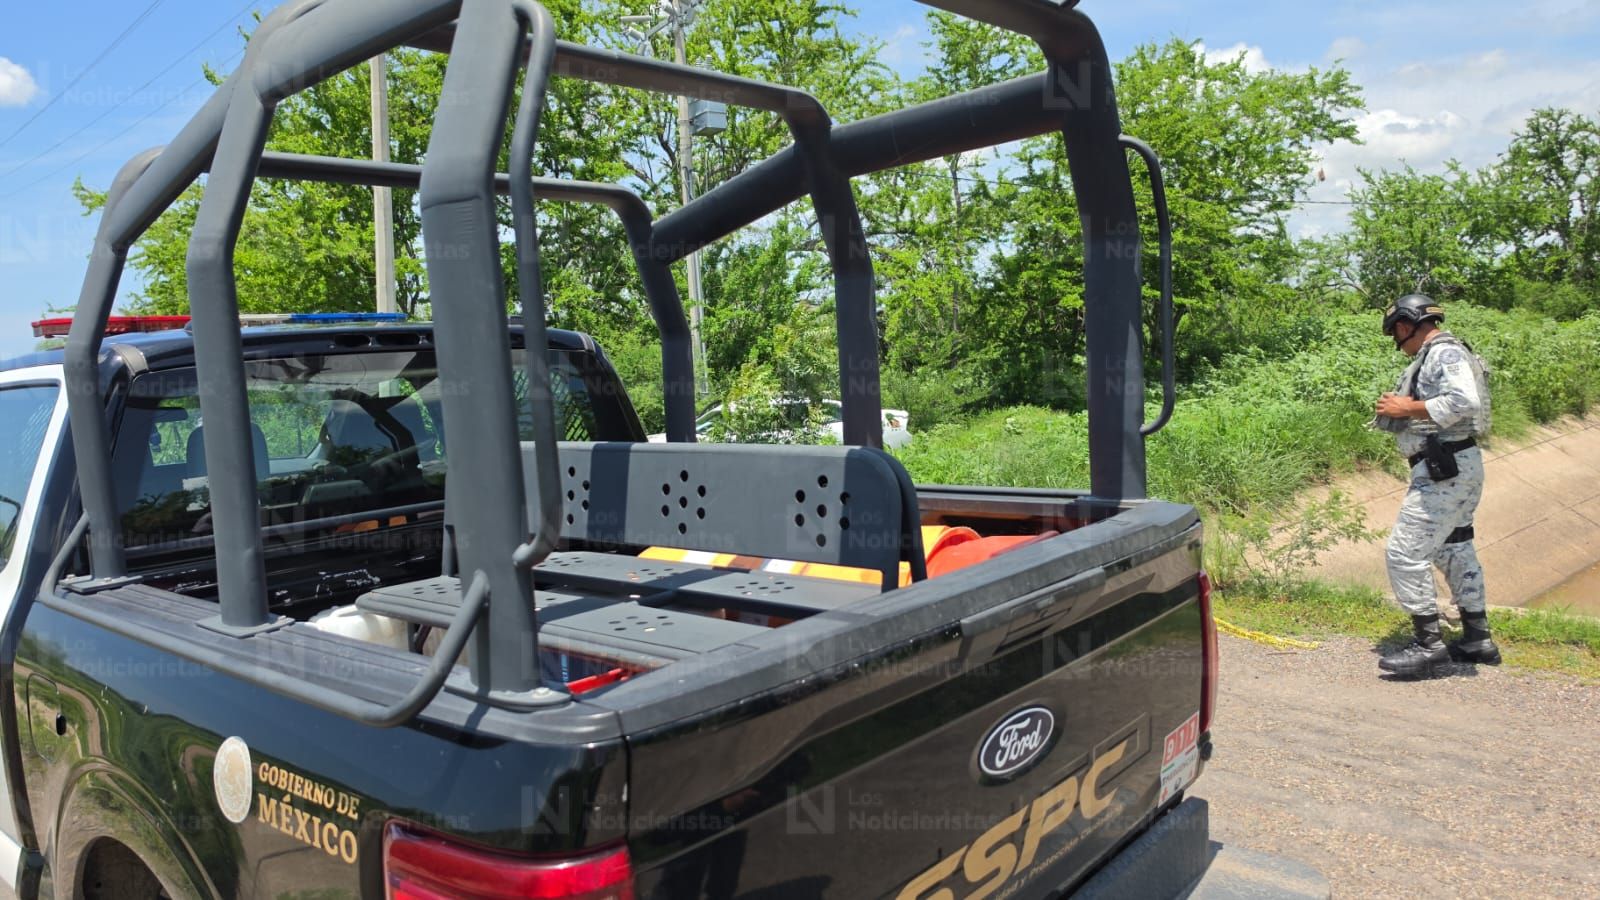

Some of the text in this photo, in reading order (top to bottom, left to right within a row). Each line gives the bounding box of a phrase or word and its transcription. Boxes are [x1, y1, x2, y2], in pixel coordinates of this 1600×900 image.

[995, 717, 1042, 768] Ford
[1165, 721, 1196, 761] 911
[259, 762, 335, 809] GOBIERNO
[336, 791, 360, 820] DE
[258, 793, 358, 864] MÉXICO
